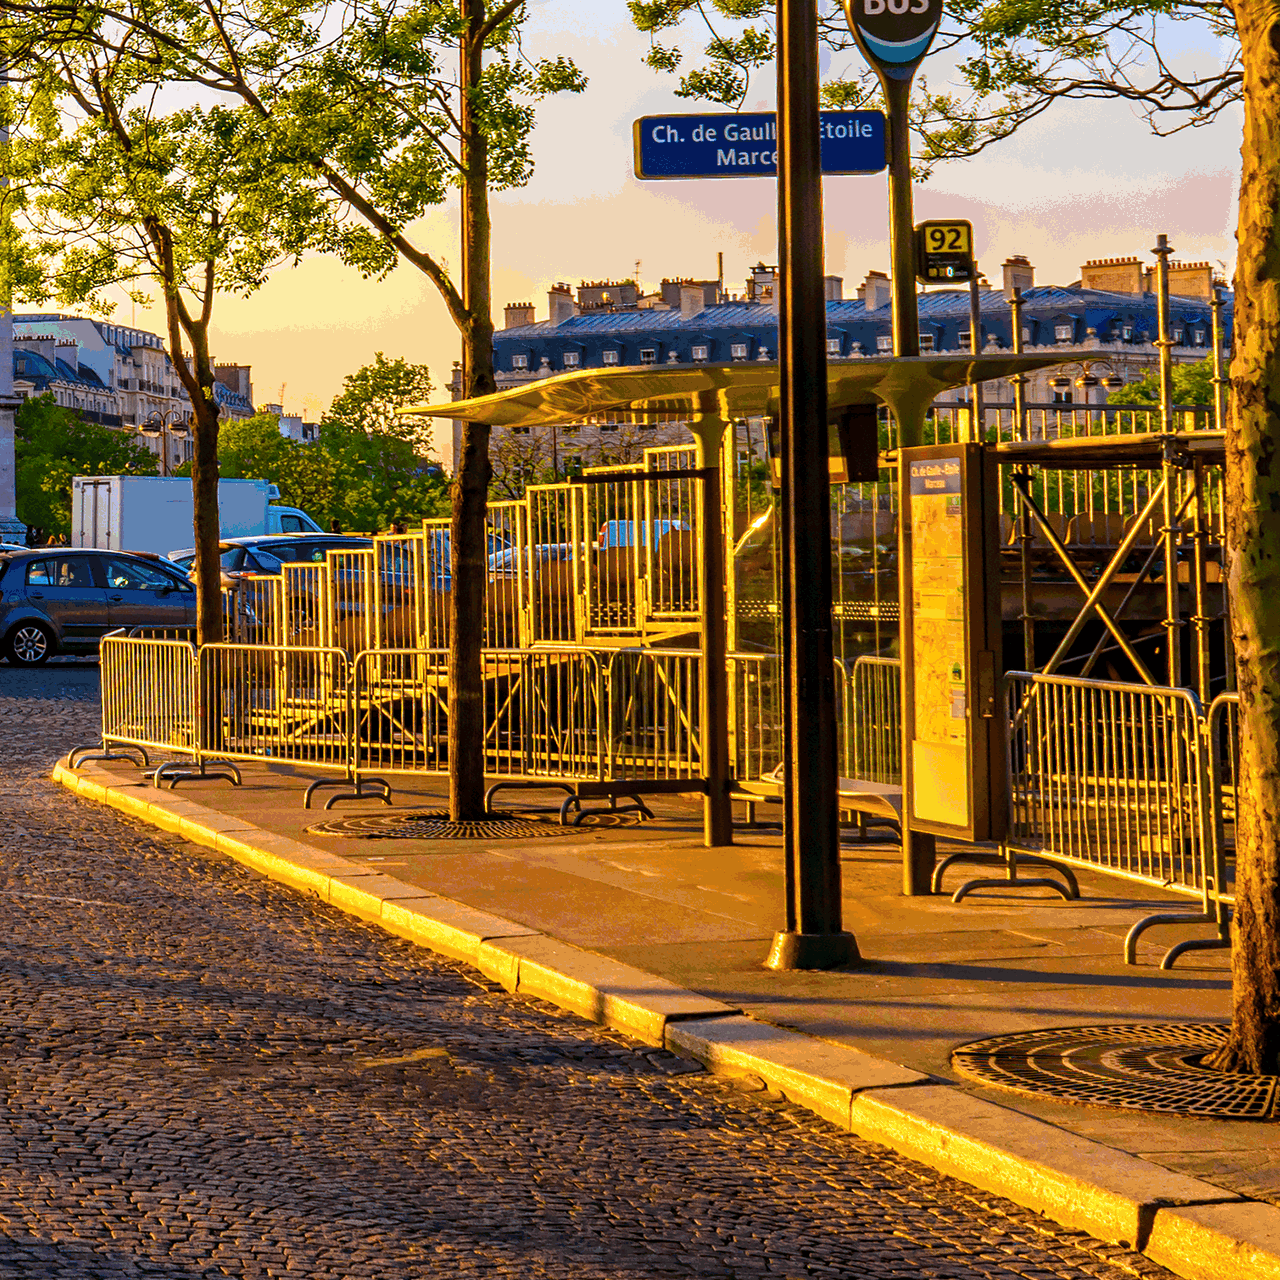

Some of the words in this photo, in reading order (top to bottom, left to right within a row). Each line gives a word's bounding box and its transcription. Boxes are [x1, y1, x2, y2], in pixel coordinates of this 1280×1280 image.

[652, 124, 685, 143] Ch.
[692, 123, 717, 142] de
[723, 122, 776, 142] Gaull
[716, 148, 778, 166] Marce
[930, 227, 963, 251] 92
